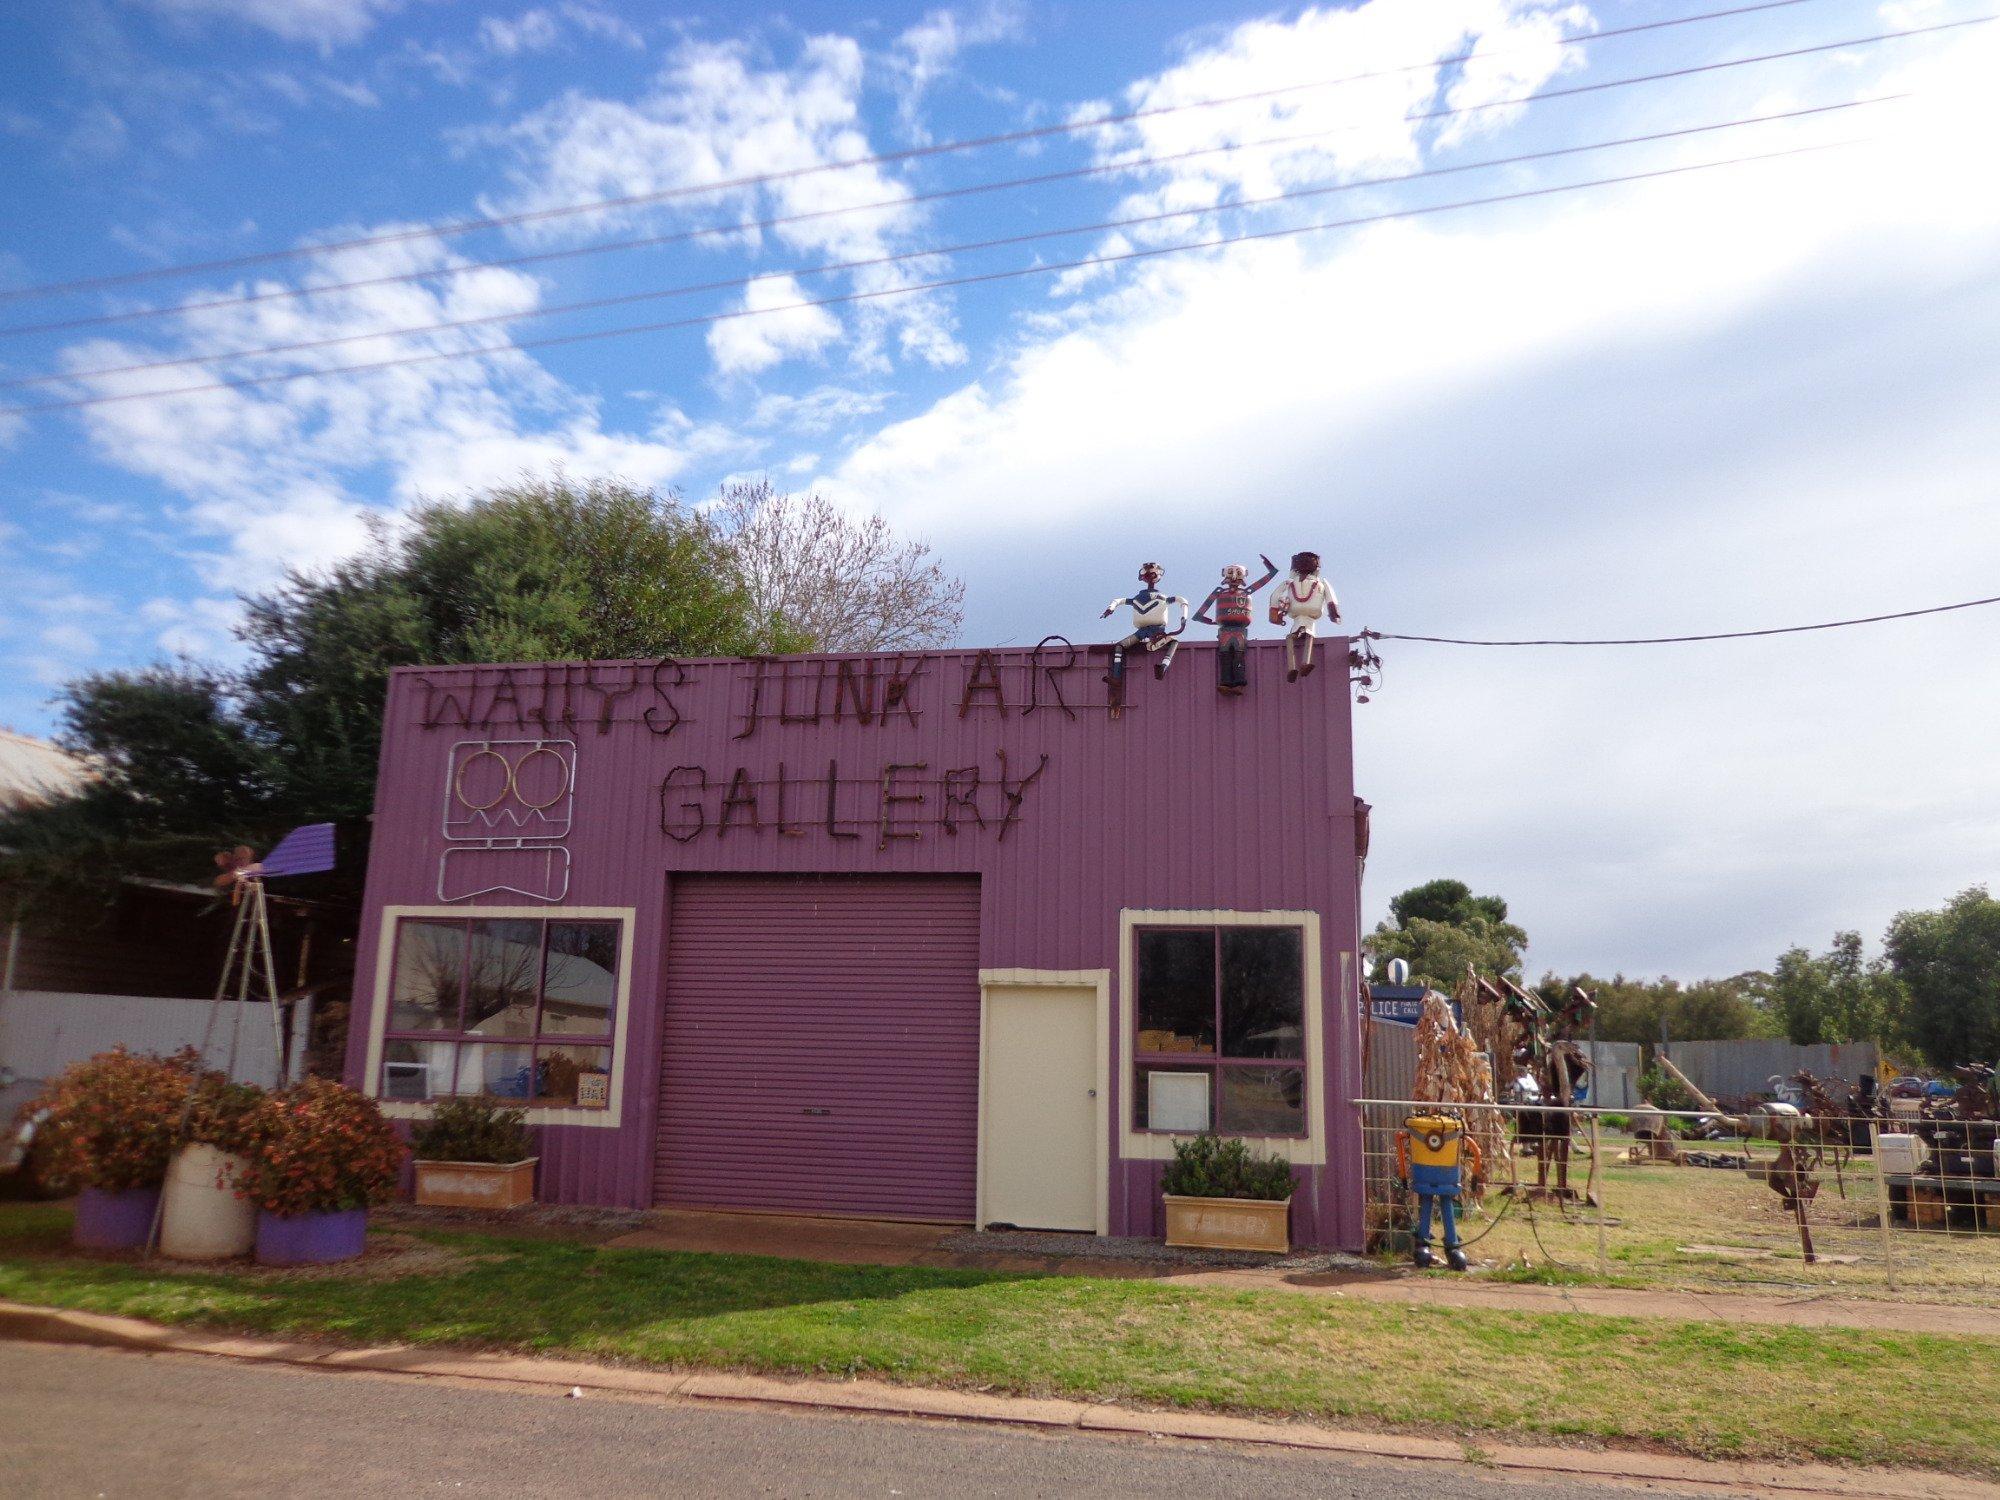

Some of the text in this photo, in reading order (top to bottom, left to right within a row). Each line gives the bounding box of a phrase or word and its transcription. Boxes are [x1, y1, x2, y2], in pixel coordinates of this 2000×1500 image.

[417, 657, 685, 736] WALLYS
[732, 653, 927, 739] JUNK
[660, 748, 1049, 850] GALLERY
[1360, 1001, 1399, 1016] PLICE
